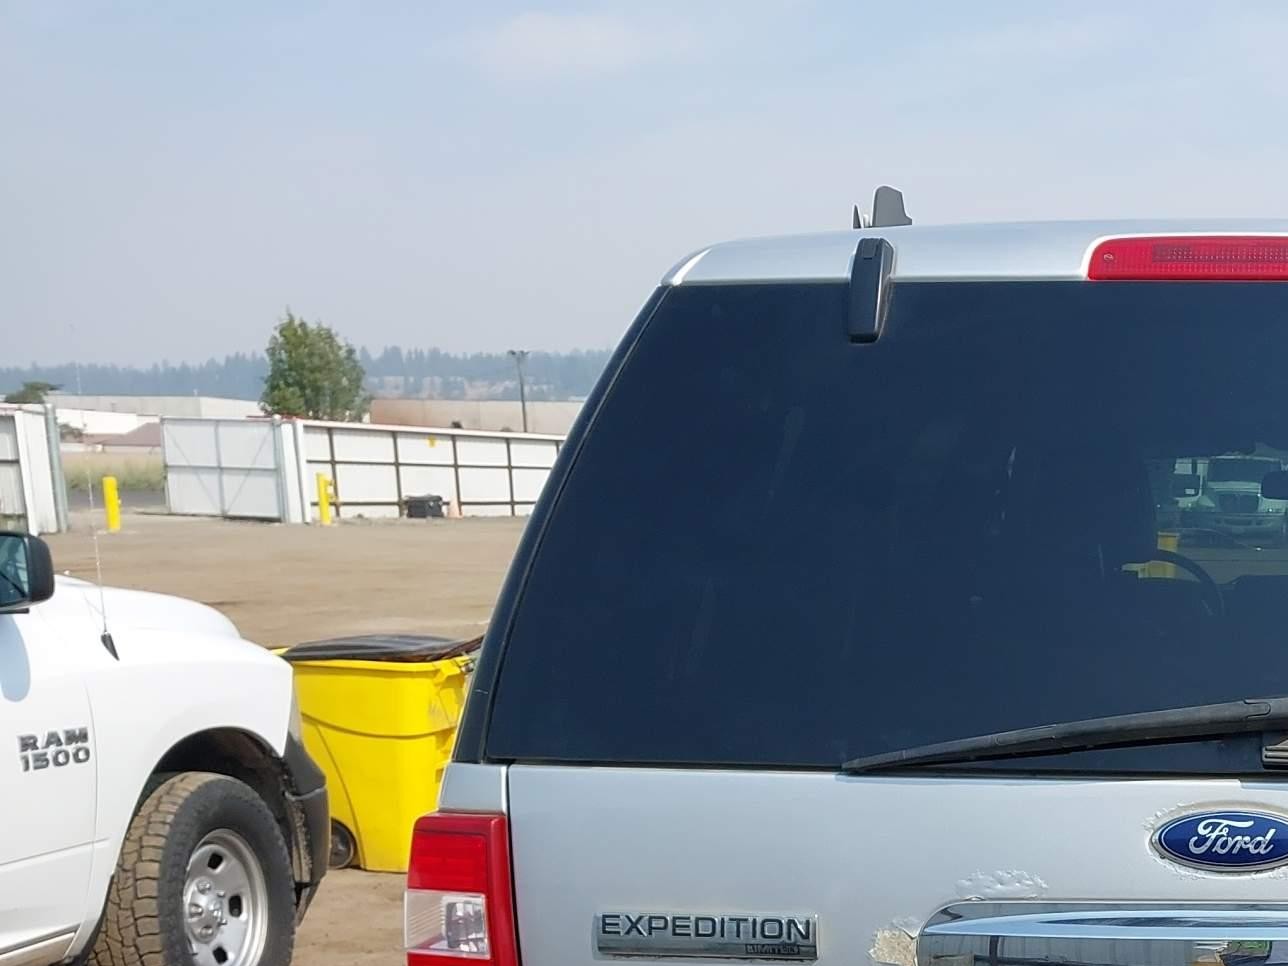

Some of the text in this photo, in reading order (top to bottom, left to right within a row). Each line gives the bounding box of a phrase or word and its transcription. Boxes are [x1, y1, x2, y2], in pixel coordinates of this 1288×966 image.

[18, 727, 89, 752] RAM
[20, 746, 91, 772] 1500
[1188, 818, 1277, 855] Ford
[600, 914, 811, 940] EXPEDITION
